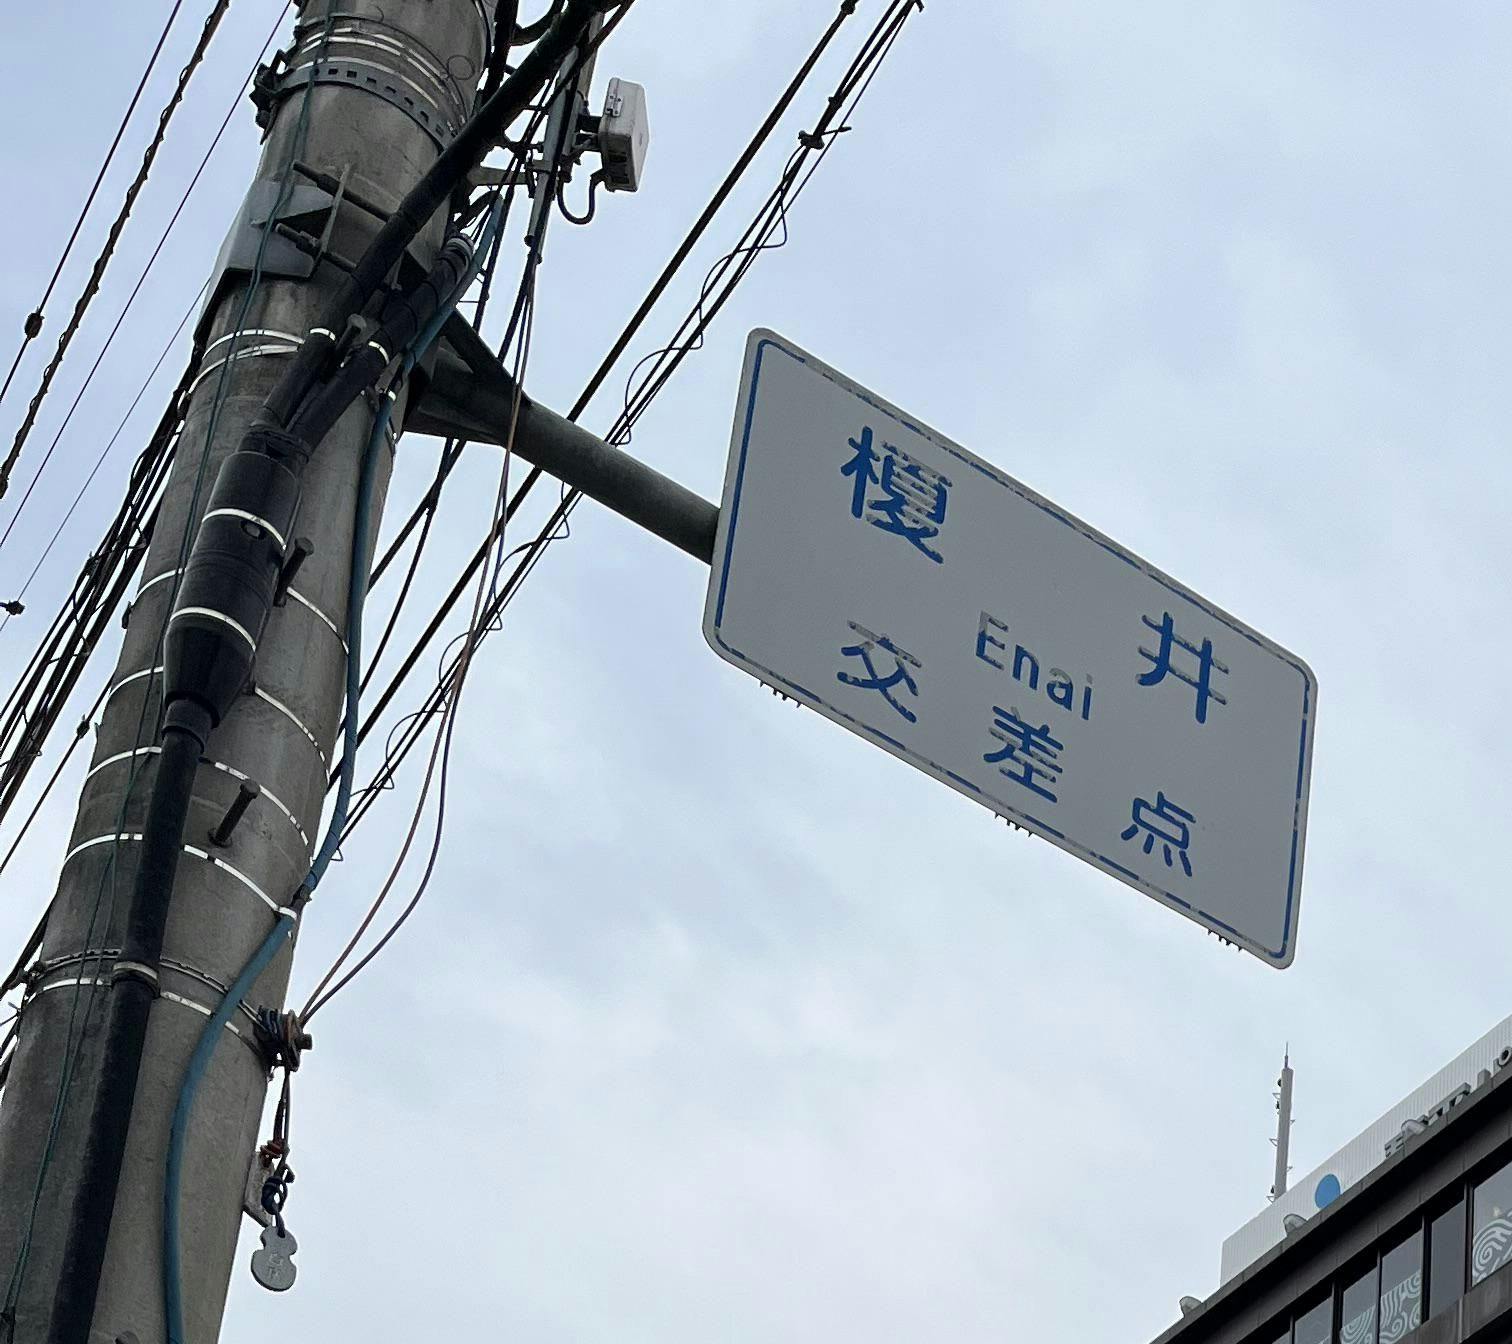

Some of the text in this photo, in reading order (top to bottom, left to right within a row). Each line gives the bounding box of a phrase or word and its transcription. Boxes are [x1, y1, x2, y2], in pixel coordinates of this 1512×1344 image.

[836, 620, 1197, 878] 交差点
[975, 611, 1093, 721] Enai
